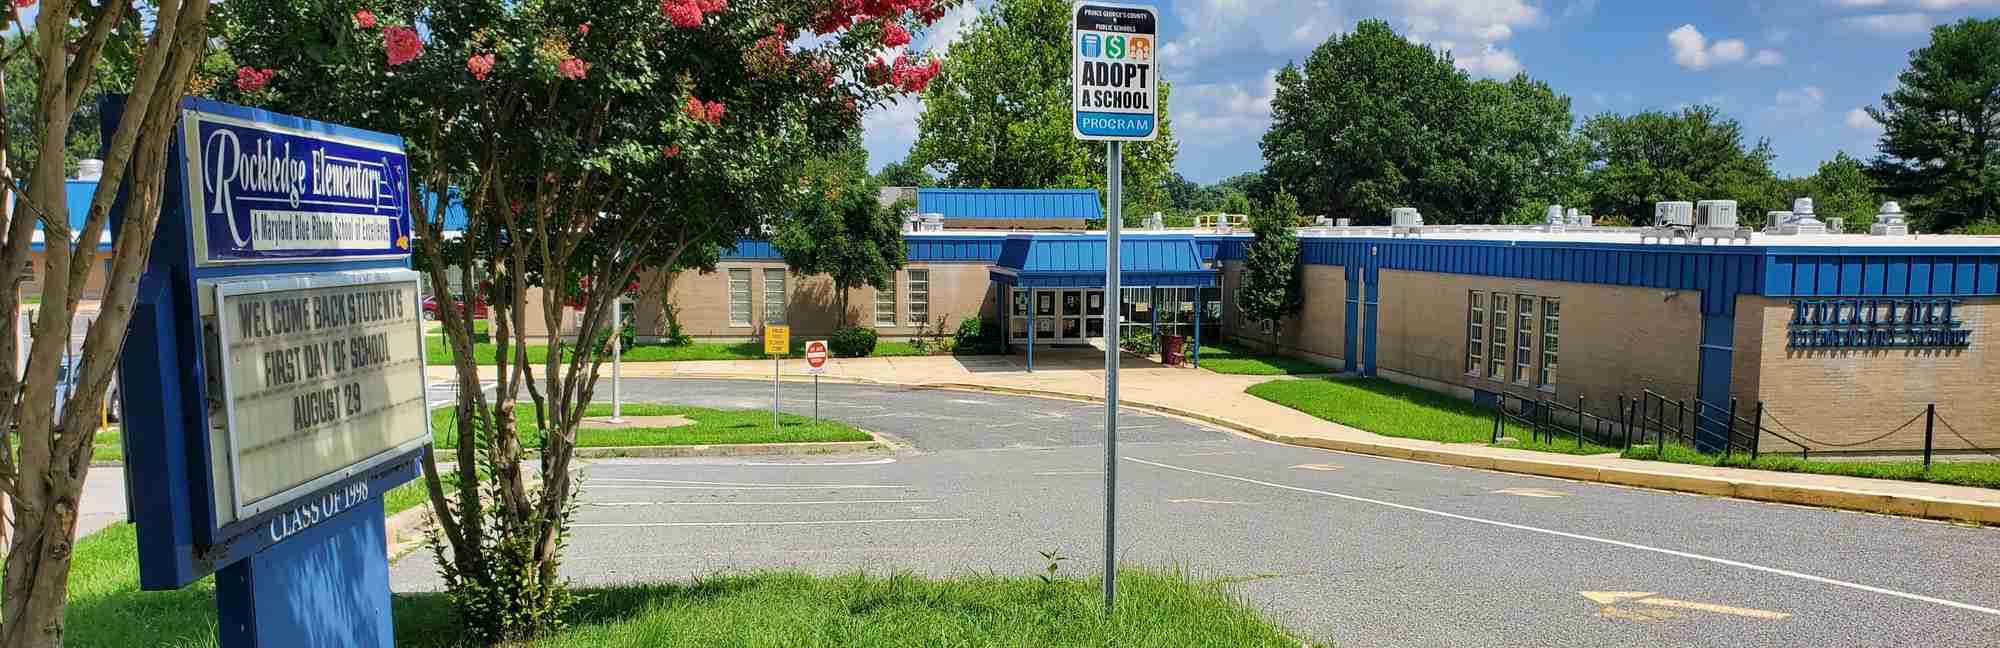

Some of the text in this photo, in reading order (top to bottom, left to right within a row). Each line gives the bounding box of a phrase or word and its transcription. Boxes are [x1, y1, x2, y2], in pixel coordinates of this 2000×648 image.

[1095, 23, 1136, 32] PUBLIC SCHOOLS
[1082, 61, 1149, 88] ADOPT
[1082, 89, 1149, 109] A SCHOOL
[1082, 117, 1148, 130] PROGRAM
[205, 129, 381, 247] Rockledge Elementary
[253, 213, 260, 240] A
[261, 212, 293, 246] Maryland
[295, 213, 310, 240] Blue
[312, 214, 332, 240] Ribbon
[335, 215, 353, 240] School
[239, 290, 403, 338] WELCOME BACK STUDENTS
[264, 332, 391, 387] FIRST DAY OF SCHOOL
[293, 382, 361, 431] AUGUST 29
[270, 480, 369, 542] CLASS OF 1998
